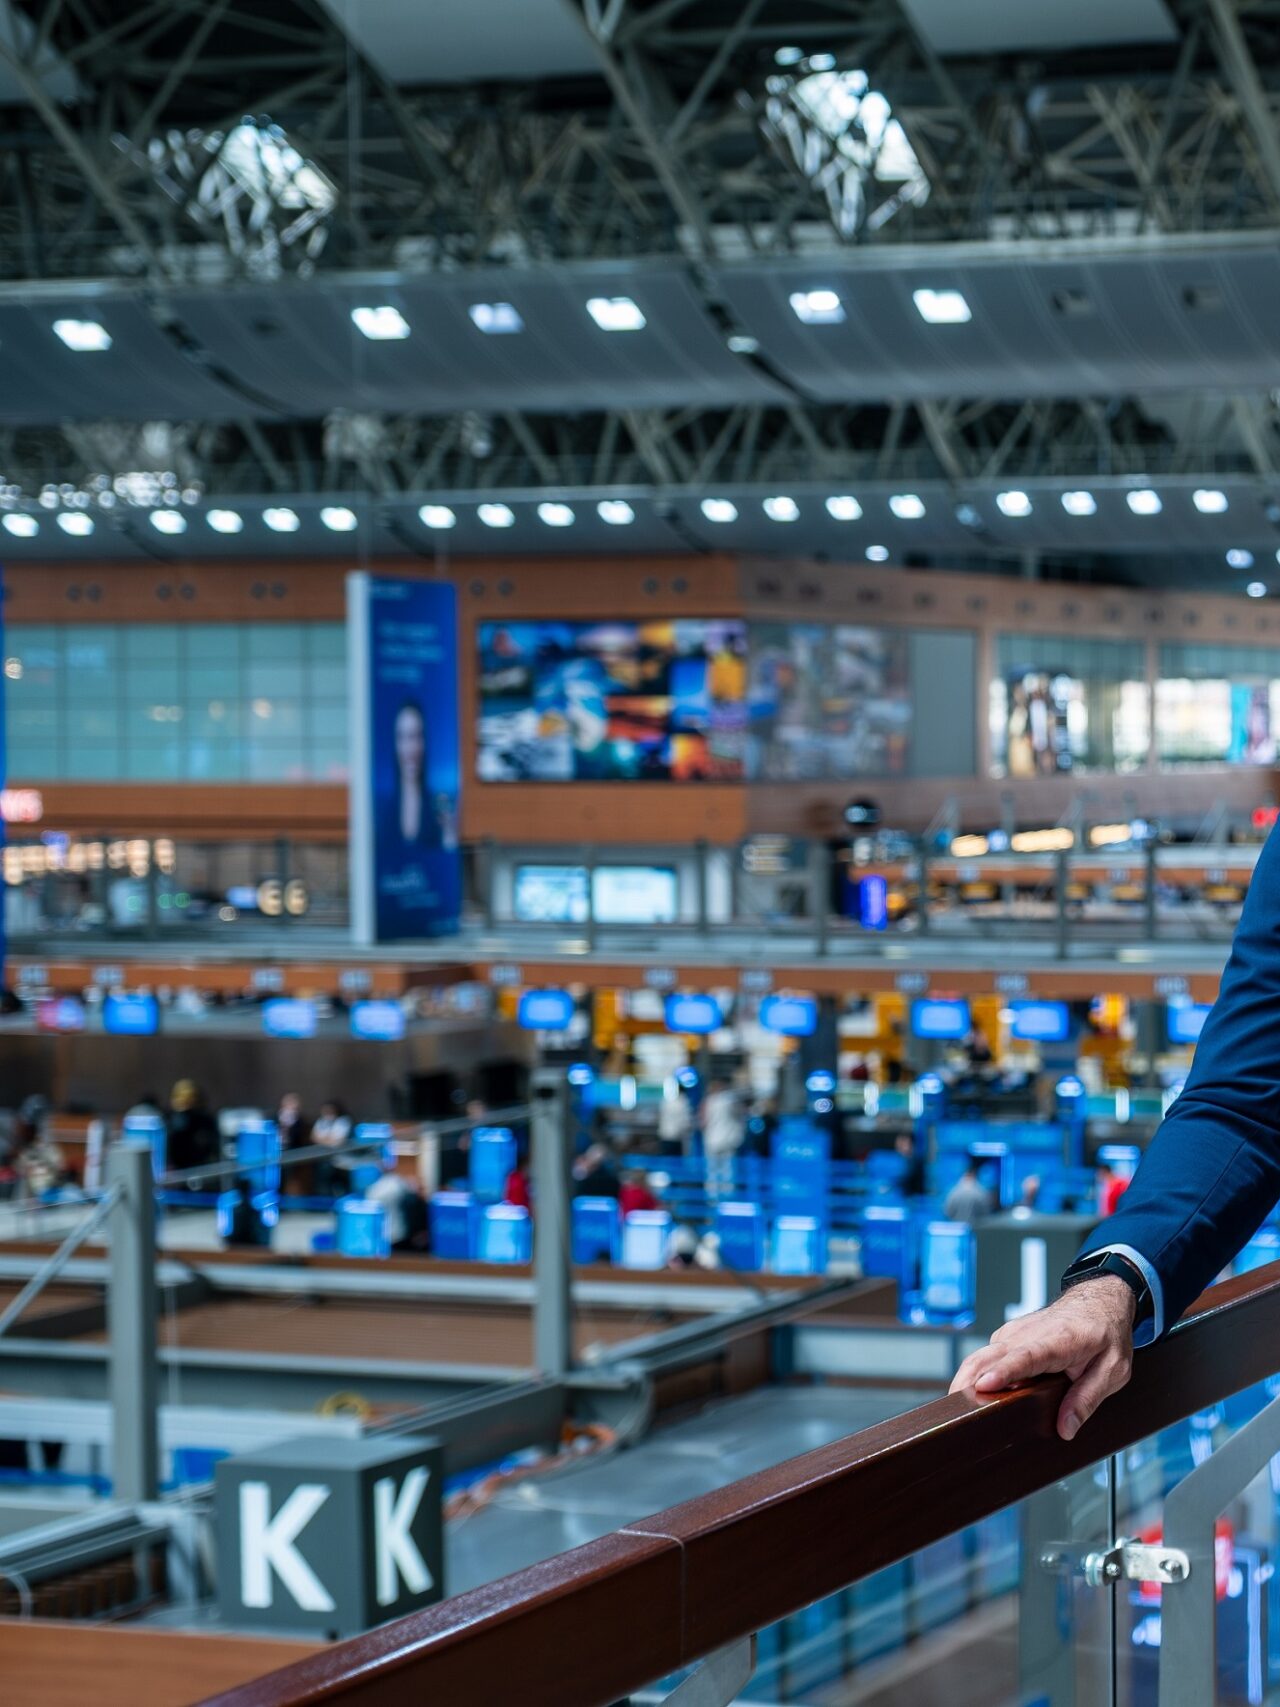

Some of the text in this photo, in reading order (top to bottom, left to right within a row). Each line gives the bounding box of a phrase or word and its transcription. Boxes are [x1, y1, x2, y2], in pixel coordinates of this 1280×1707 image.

[1004, 1237, 1047, 1322] J
[239, 1480, 336, 1612] K
[374, 1464, 434, 1607] K
